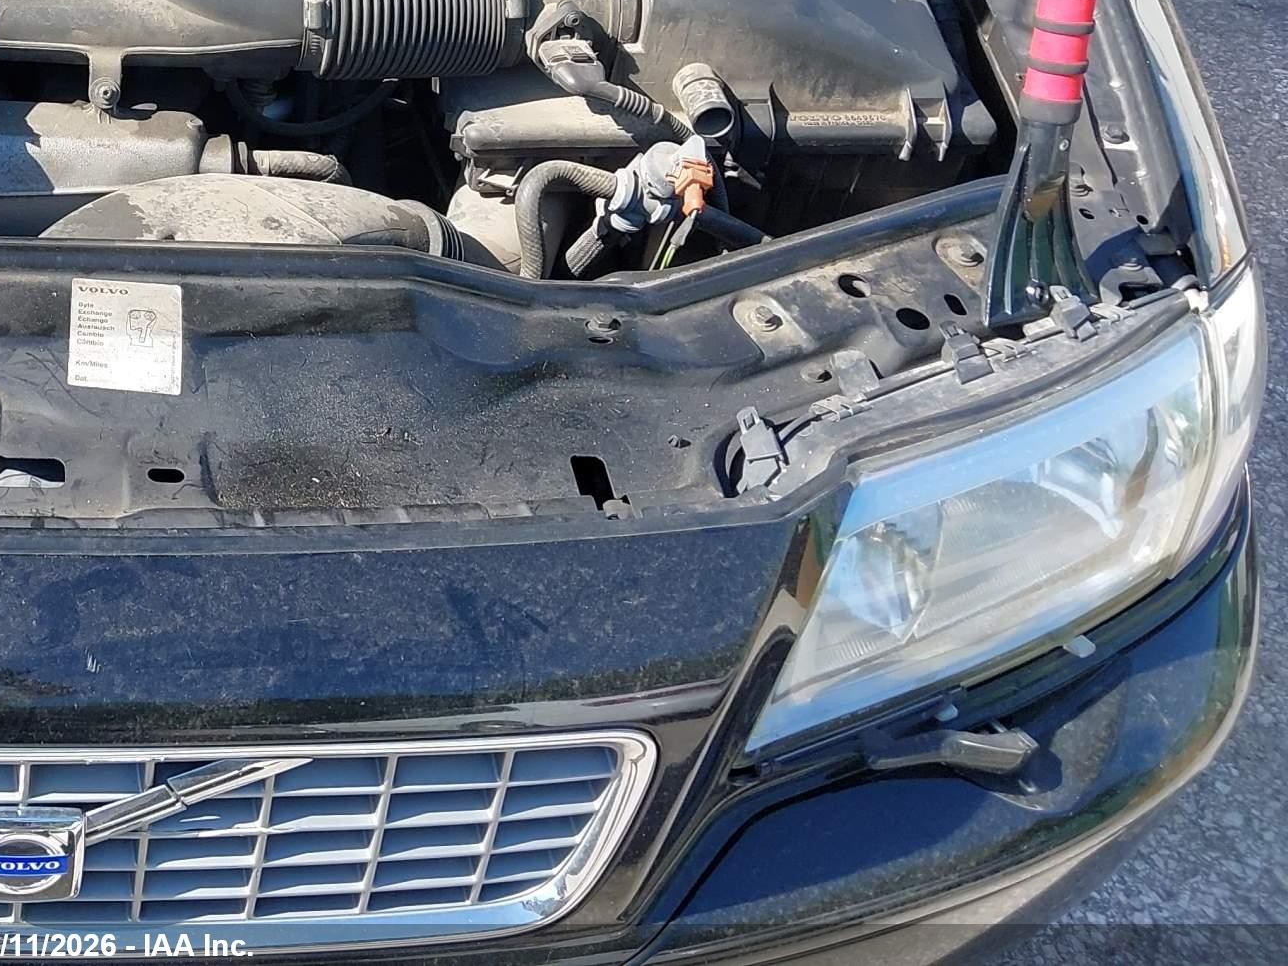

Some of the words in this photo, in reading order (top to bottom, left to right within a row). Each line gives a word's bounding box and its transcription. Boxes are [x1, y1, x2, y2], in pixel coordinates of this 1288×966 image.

[78, 286, 129, 295] VOLVO
[78, 309, 113, 317] Exchange
[77, 323, 115, 331] Austausch
[75, 360, 108, 369] Km/Miles
